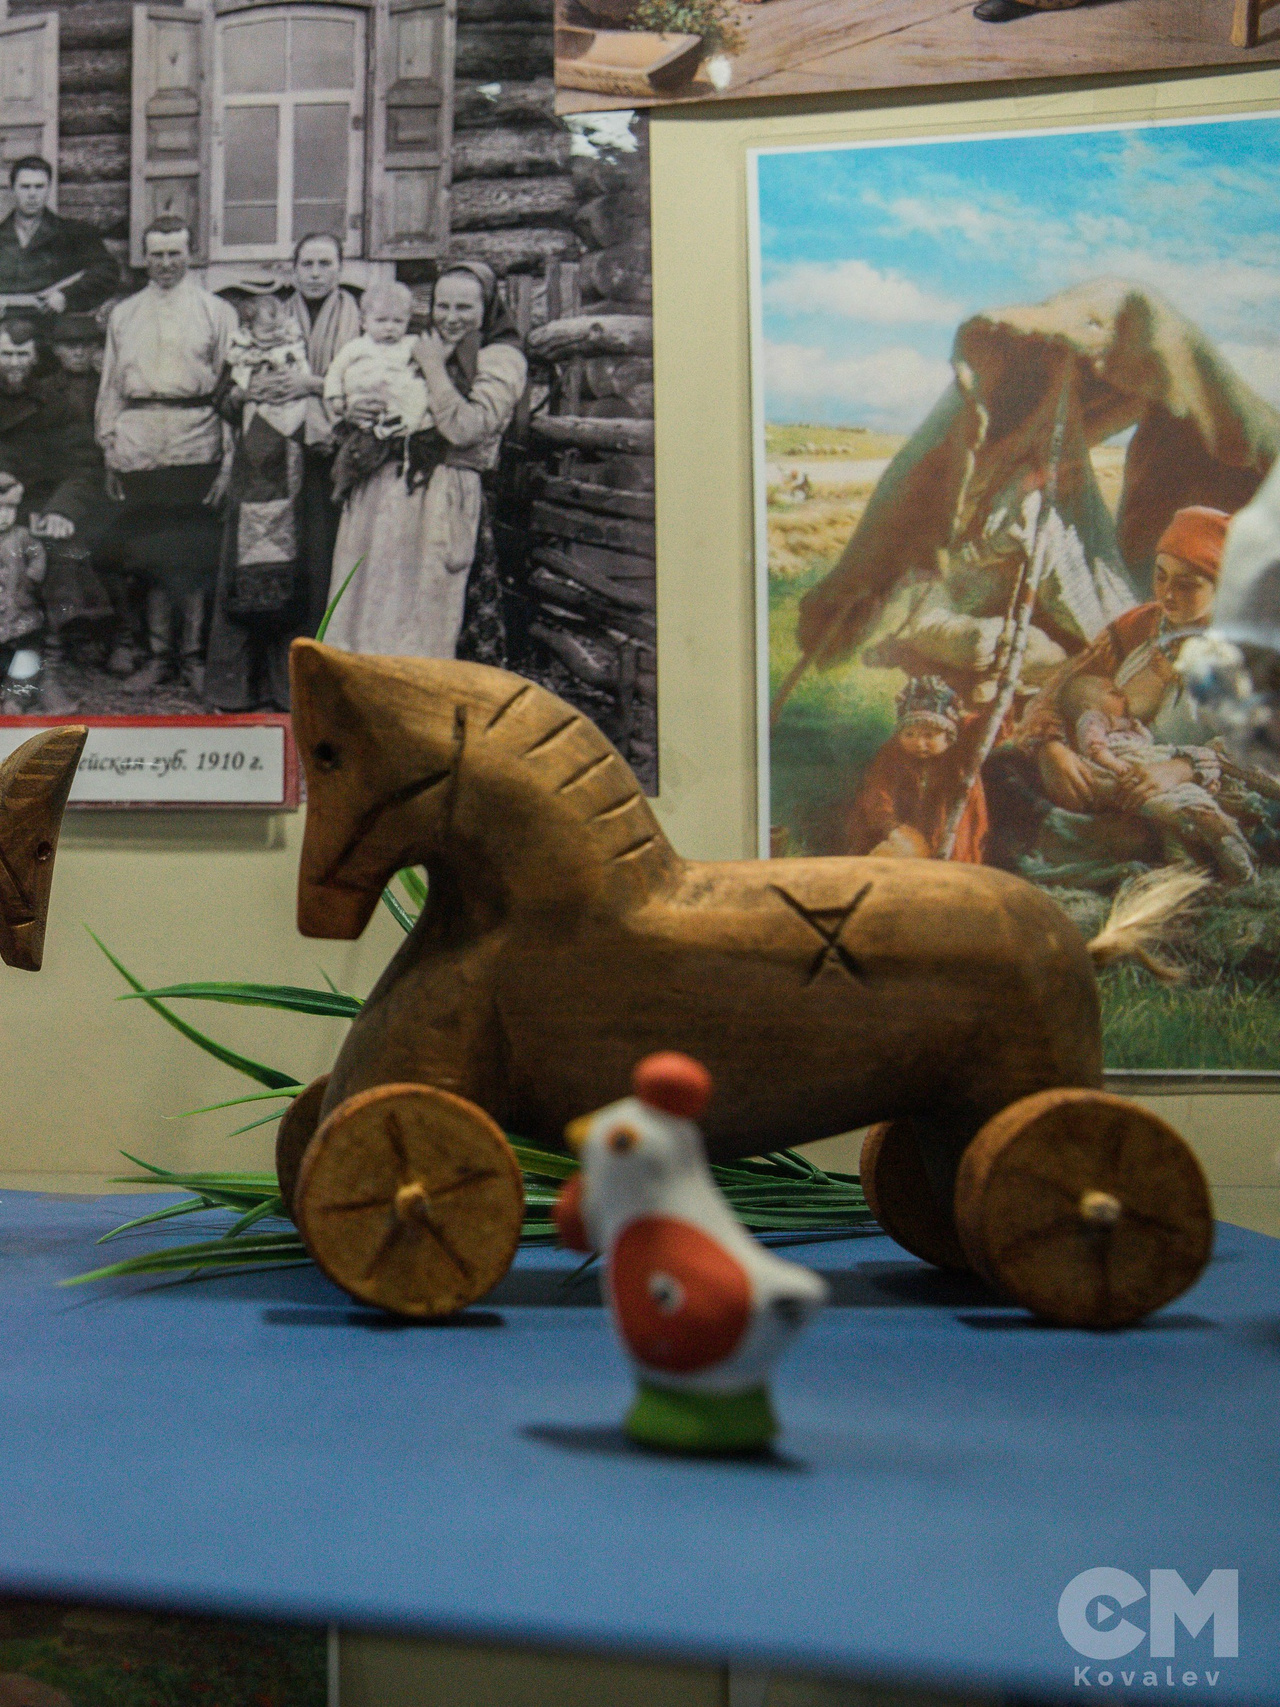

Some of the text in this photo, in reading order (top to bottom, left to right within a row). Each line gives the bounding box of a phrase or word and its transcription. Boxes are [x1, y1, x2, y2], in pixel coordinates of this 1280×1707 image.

[78, 750, 265, 777] ейская губ. 1910 г.
